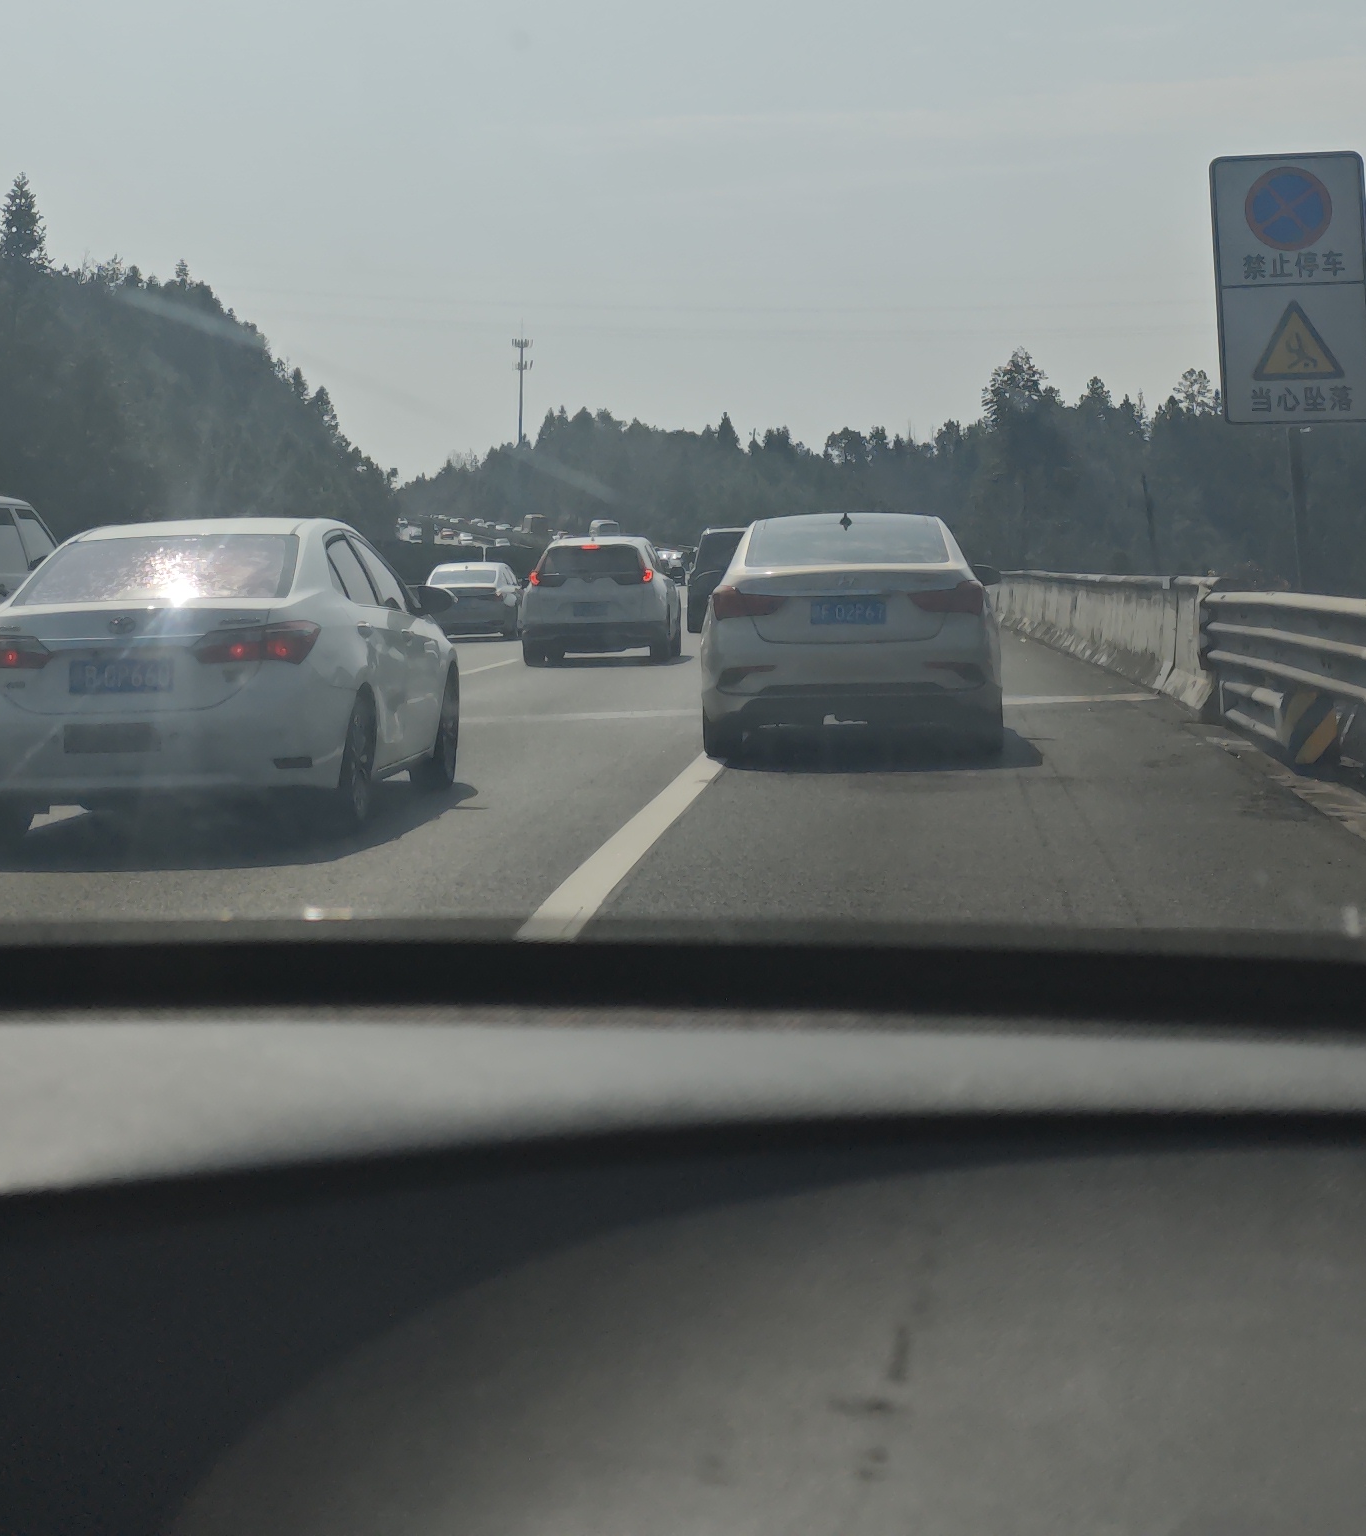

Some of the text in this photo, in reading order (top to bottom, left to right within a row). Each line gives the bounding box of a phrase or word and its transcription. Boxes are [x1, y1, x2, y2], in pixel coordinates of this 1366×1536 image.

[1243, 251, 1346, 280] 禁止停车
[1251, 385, 1353, 412] 当心坠落
